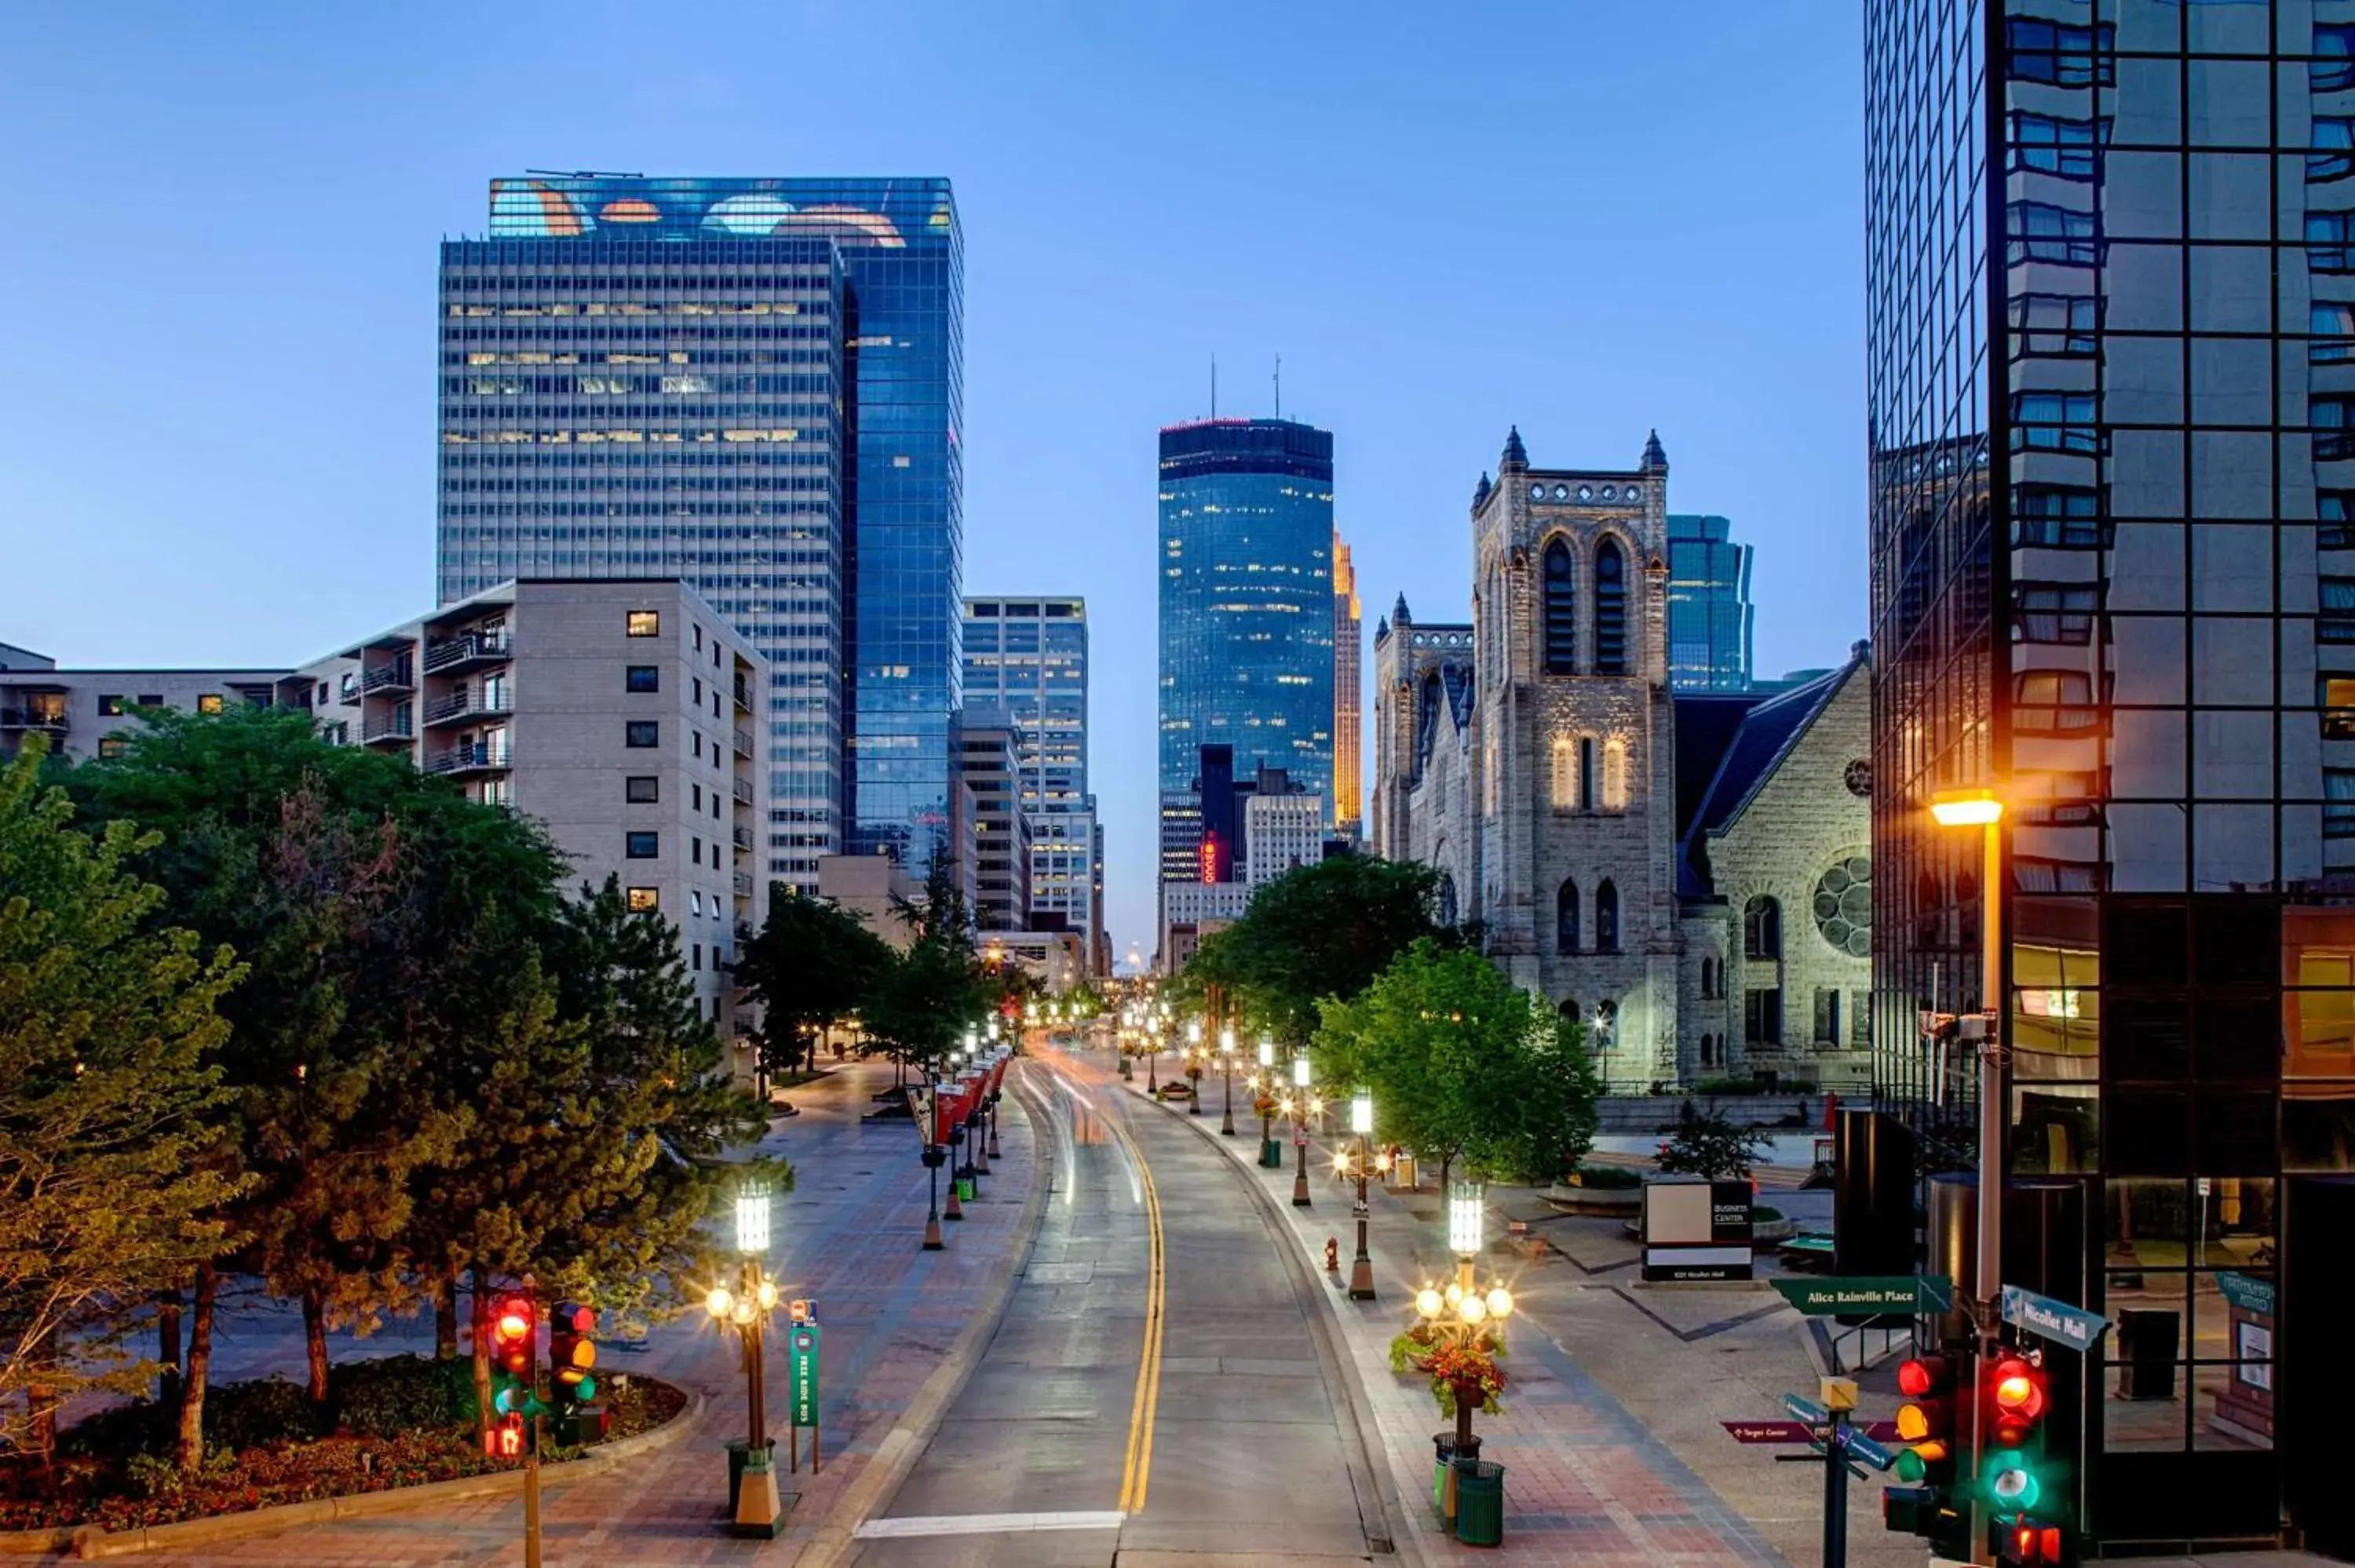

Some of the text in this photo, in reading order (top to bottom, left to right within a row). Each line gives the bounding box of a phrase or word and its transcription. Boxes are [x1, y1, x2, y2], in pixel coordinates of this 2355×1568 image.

[1808, 1290, 1915, 1304] Alice Rainville Place
[2025, 1301, 2086, 1340] Nicollet Mall
